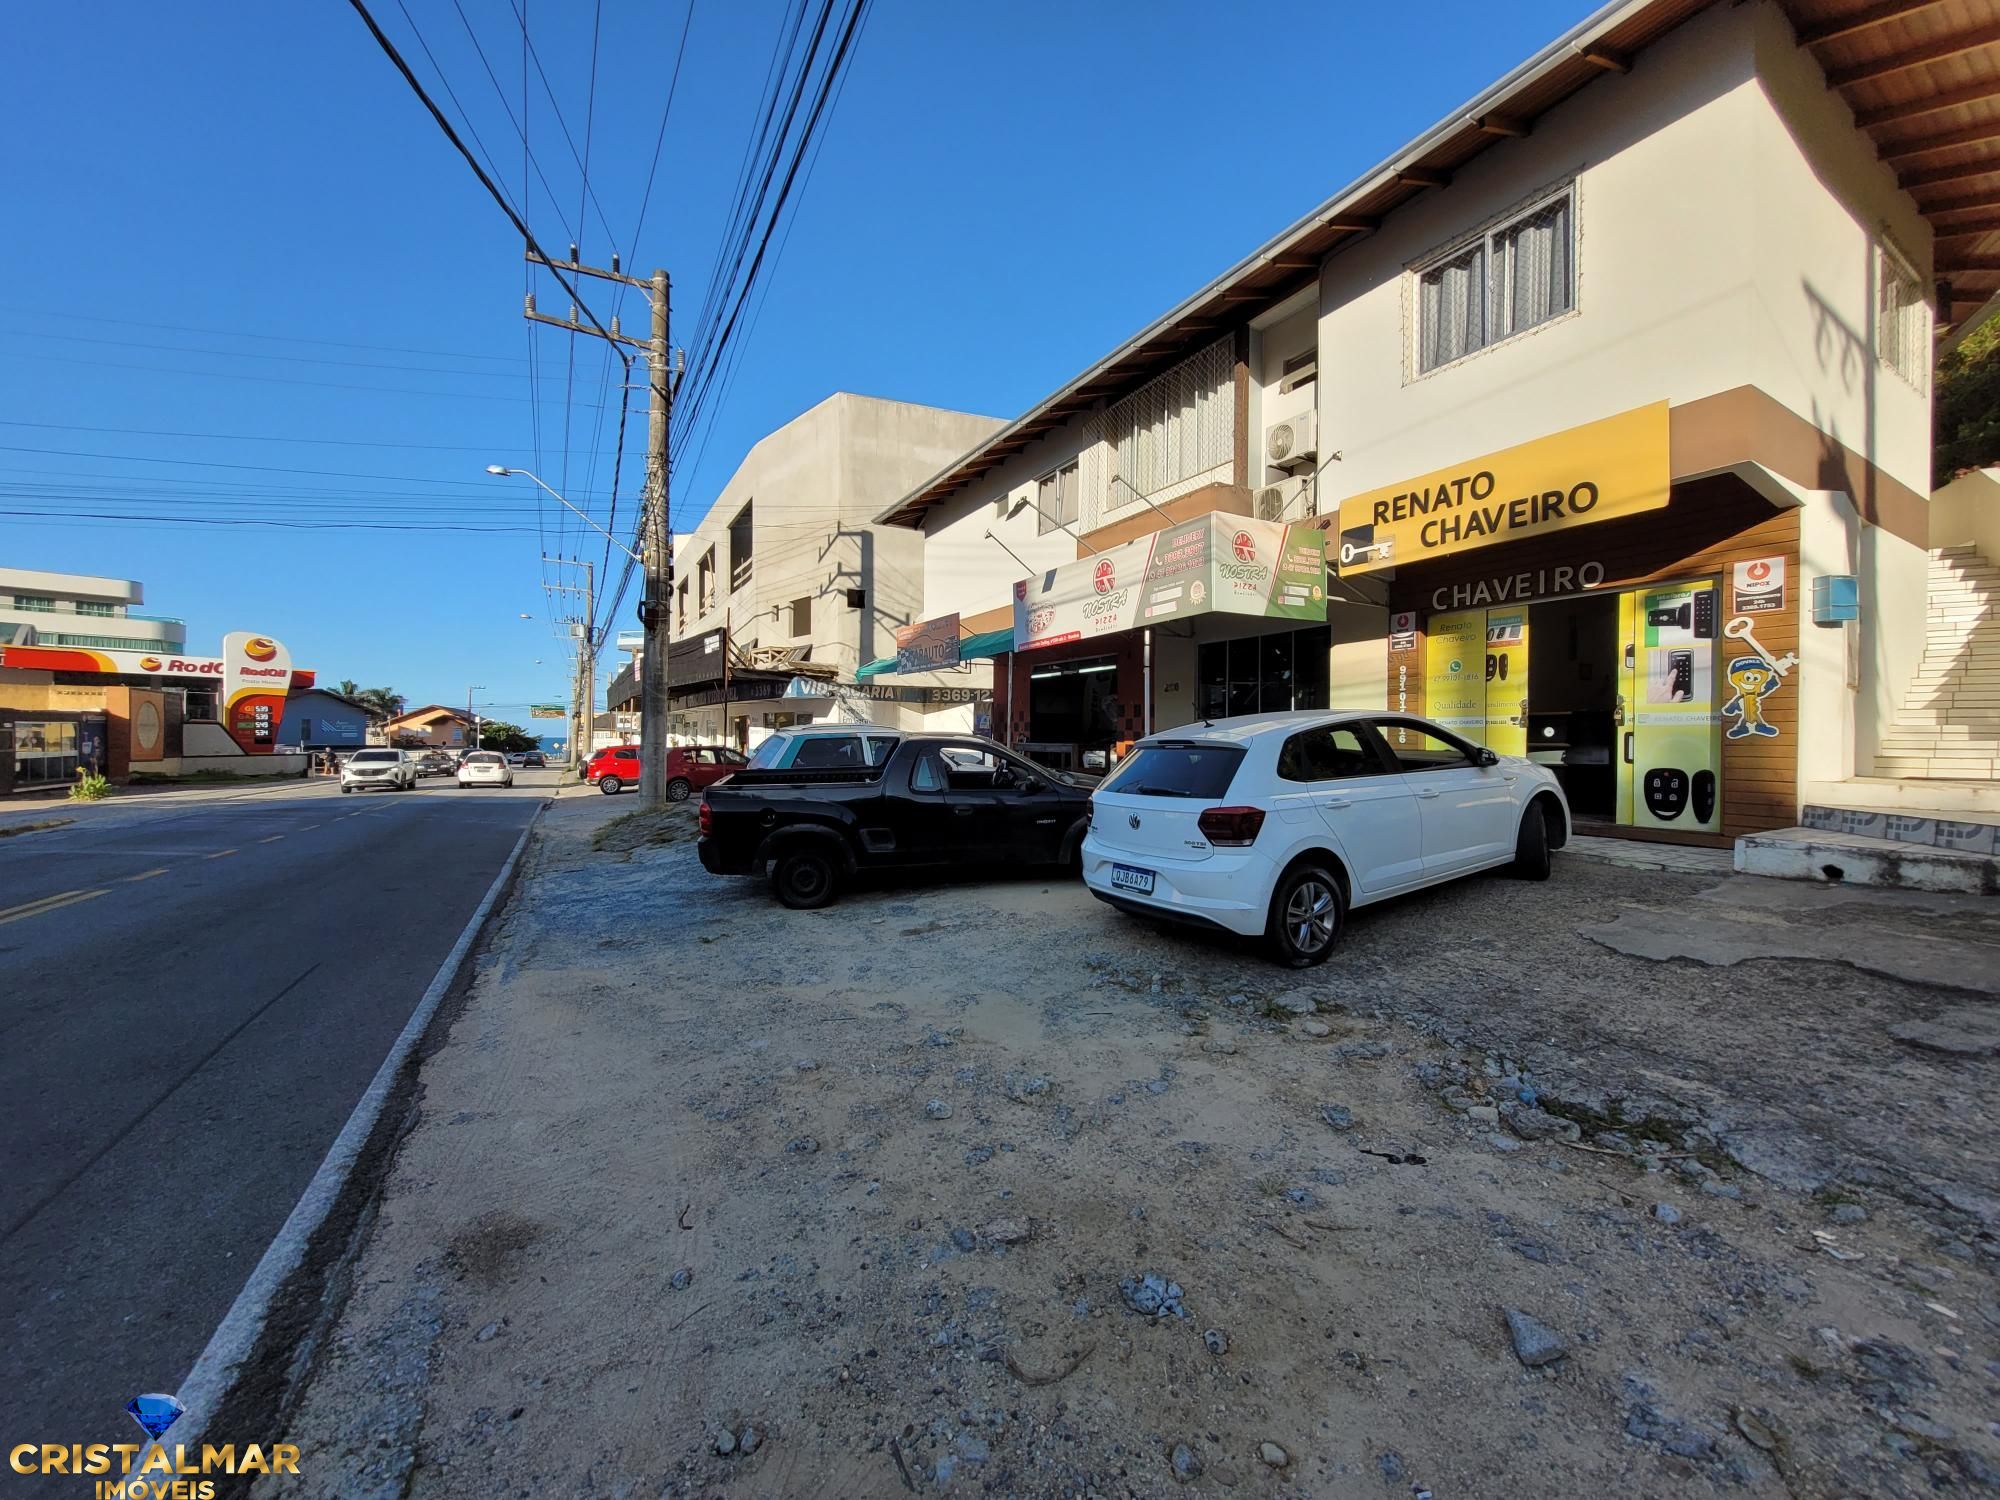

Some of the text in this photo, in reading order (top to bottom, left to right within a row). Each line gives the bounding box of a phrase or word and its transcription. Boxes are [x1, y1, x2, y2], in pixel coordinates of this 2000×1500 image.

[1374, 471, 1495, 526] RENATO
[1420, 482, 1599, 548] CHAVEIRO
[1220, 563, 1268, 581] NOSTRA
[1233, 581, 1257, 591] PIZZA
[1432, 561, 1605, 610] CHAVEIRO
[1746, 580, 1770, 588] NIPOX
[1083, 588, 1128, 619] NOSTRA
[1095, 613, 1117, 625] PIZZA
[1440, 622, 1473, 632] Renato
[1436, 632, 1477, 644] Chaveiro
[1434, 699, 1477, 711] Qualidade
[1116, 870, 1149, 888] QJB6A79
